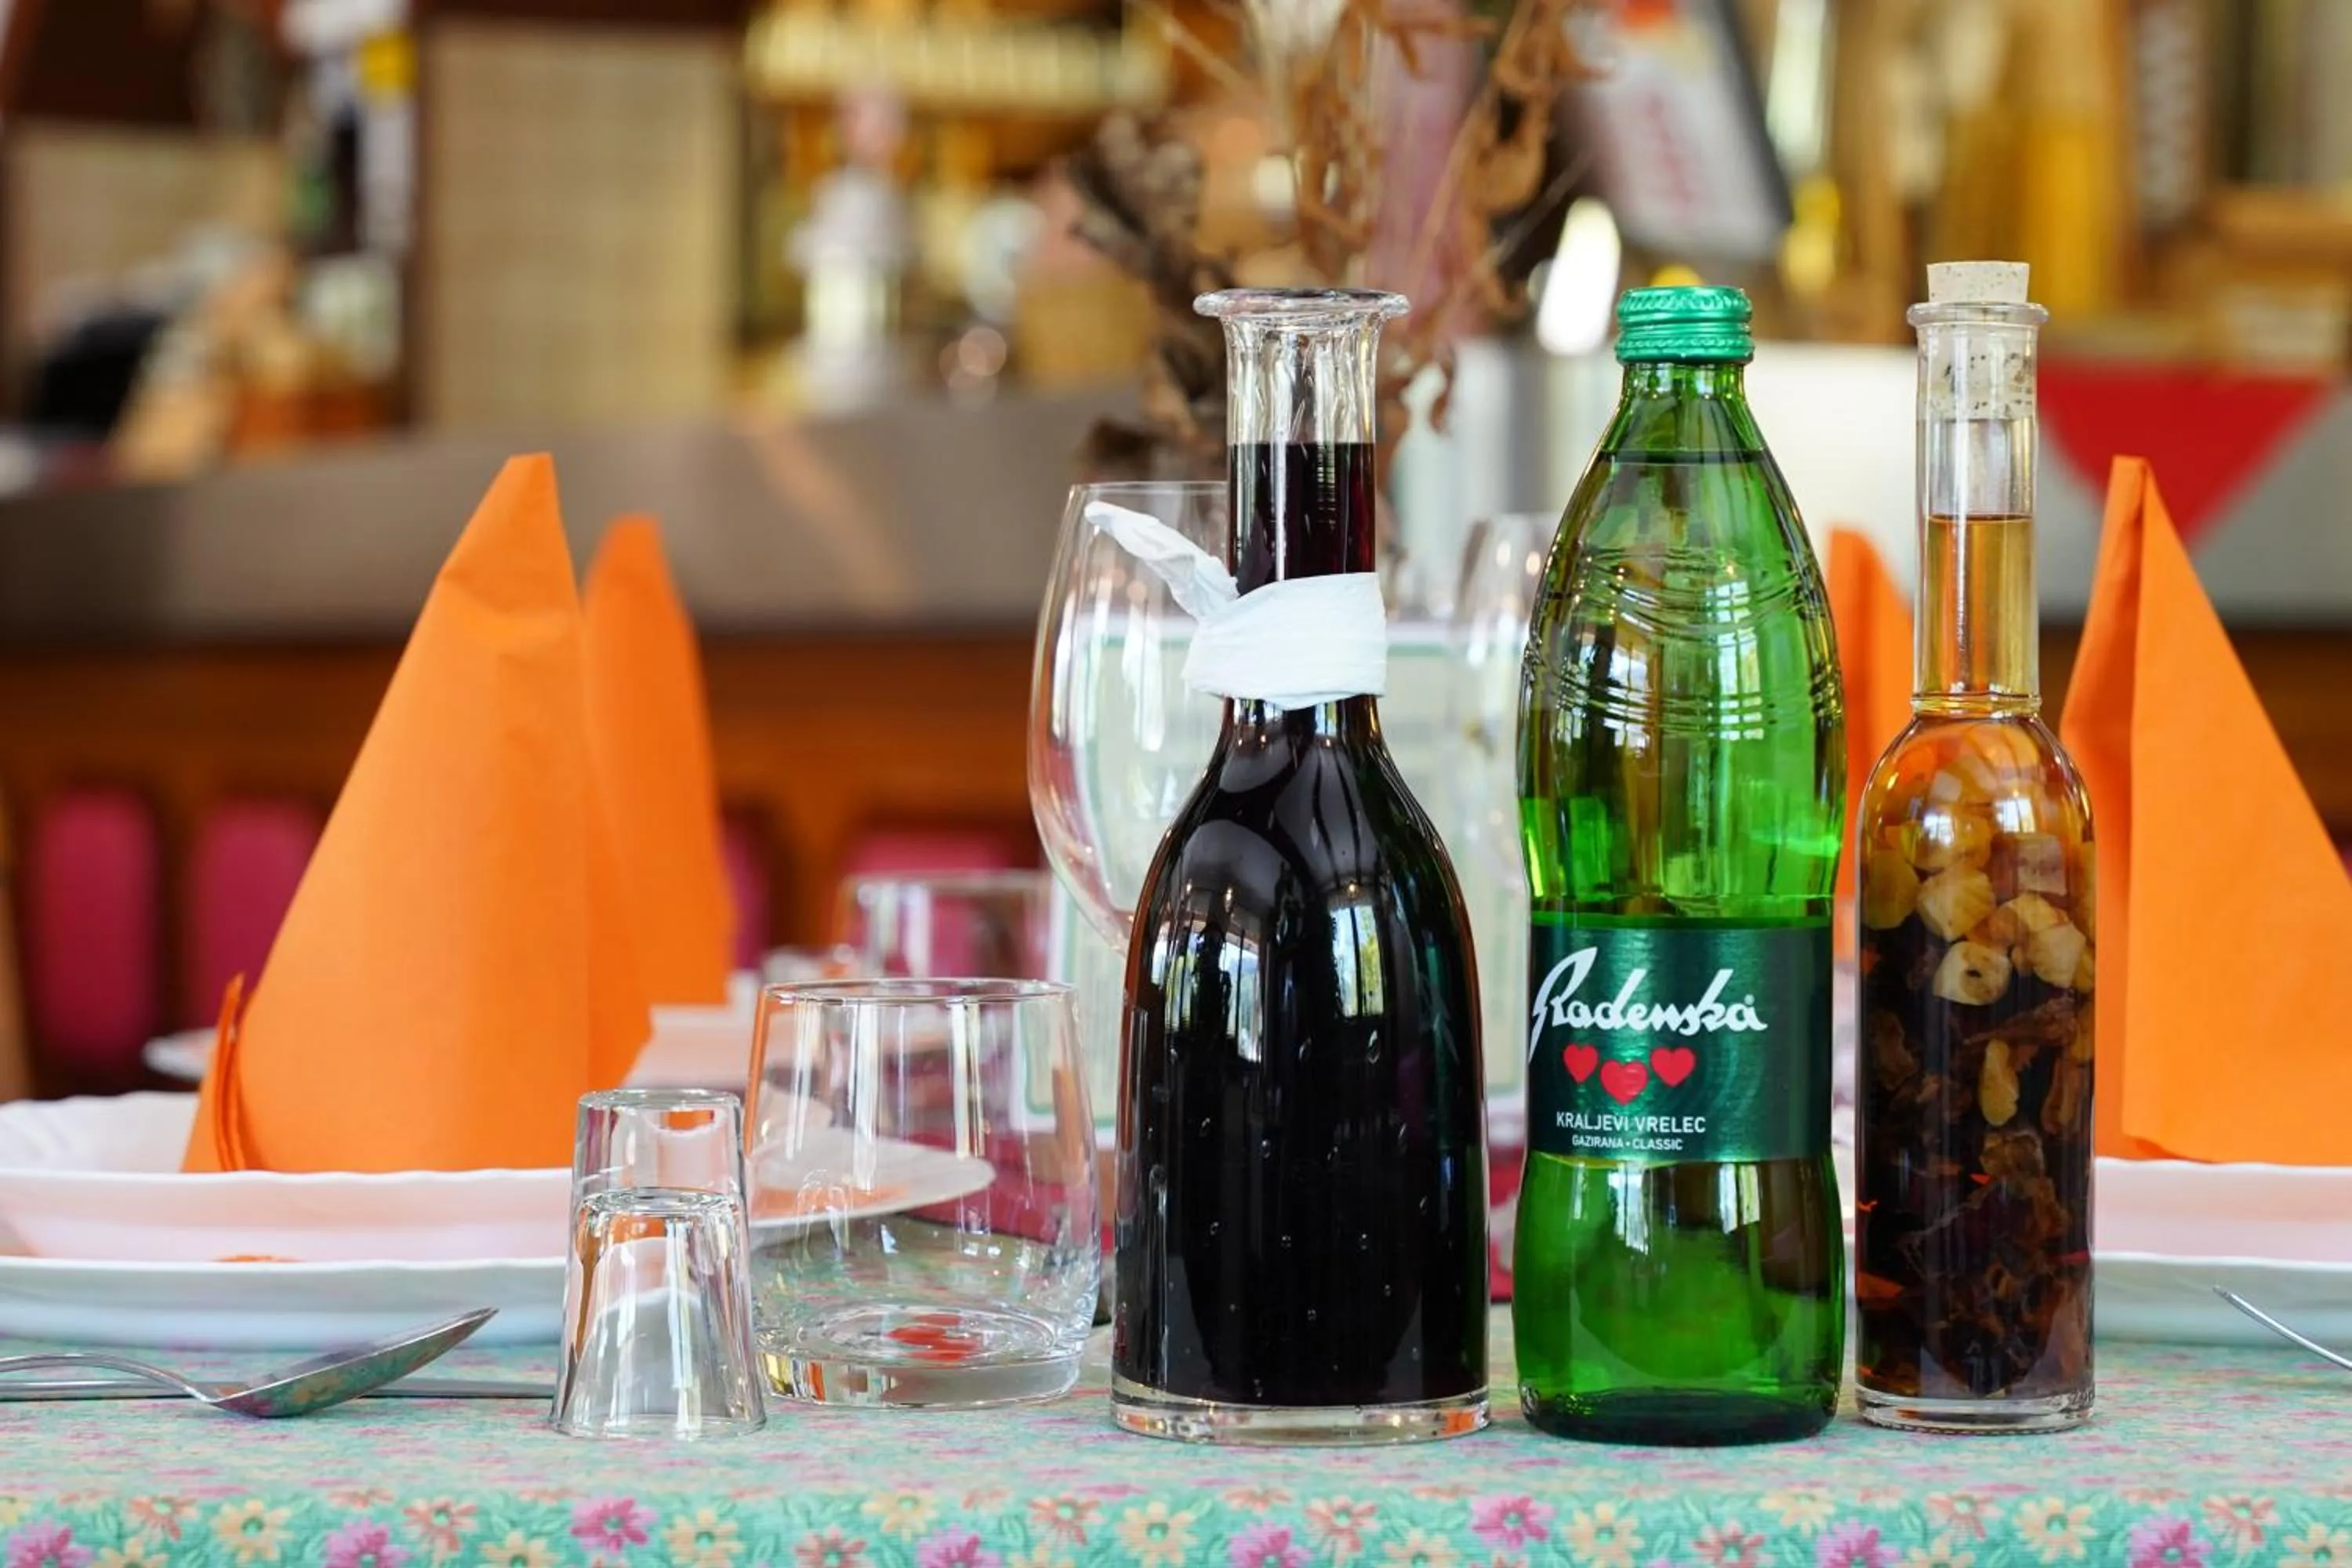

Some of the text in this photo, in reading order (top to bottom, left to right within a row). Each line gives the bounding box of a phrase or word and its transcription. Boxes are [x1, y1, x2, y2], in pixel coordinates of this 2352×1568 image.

[1528, 946, 1768, 1064] Radenska
[1556, 1111, 1706, 1134] KRALJEVI VRELEC
[1572, 1134, 1683, 1151] GAZIRANA CLASSIC
